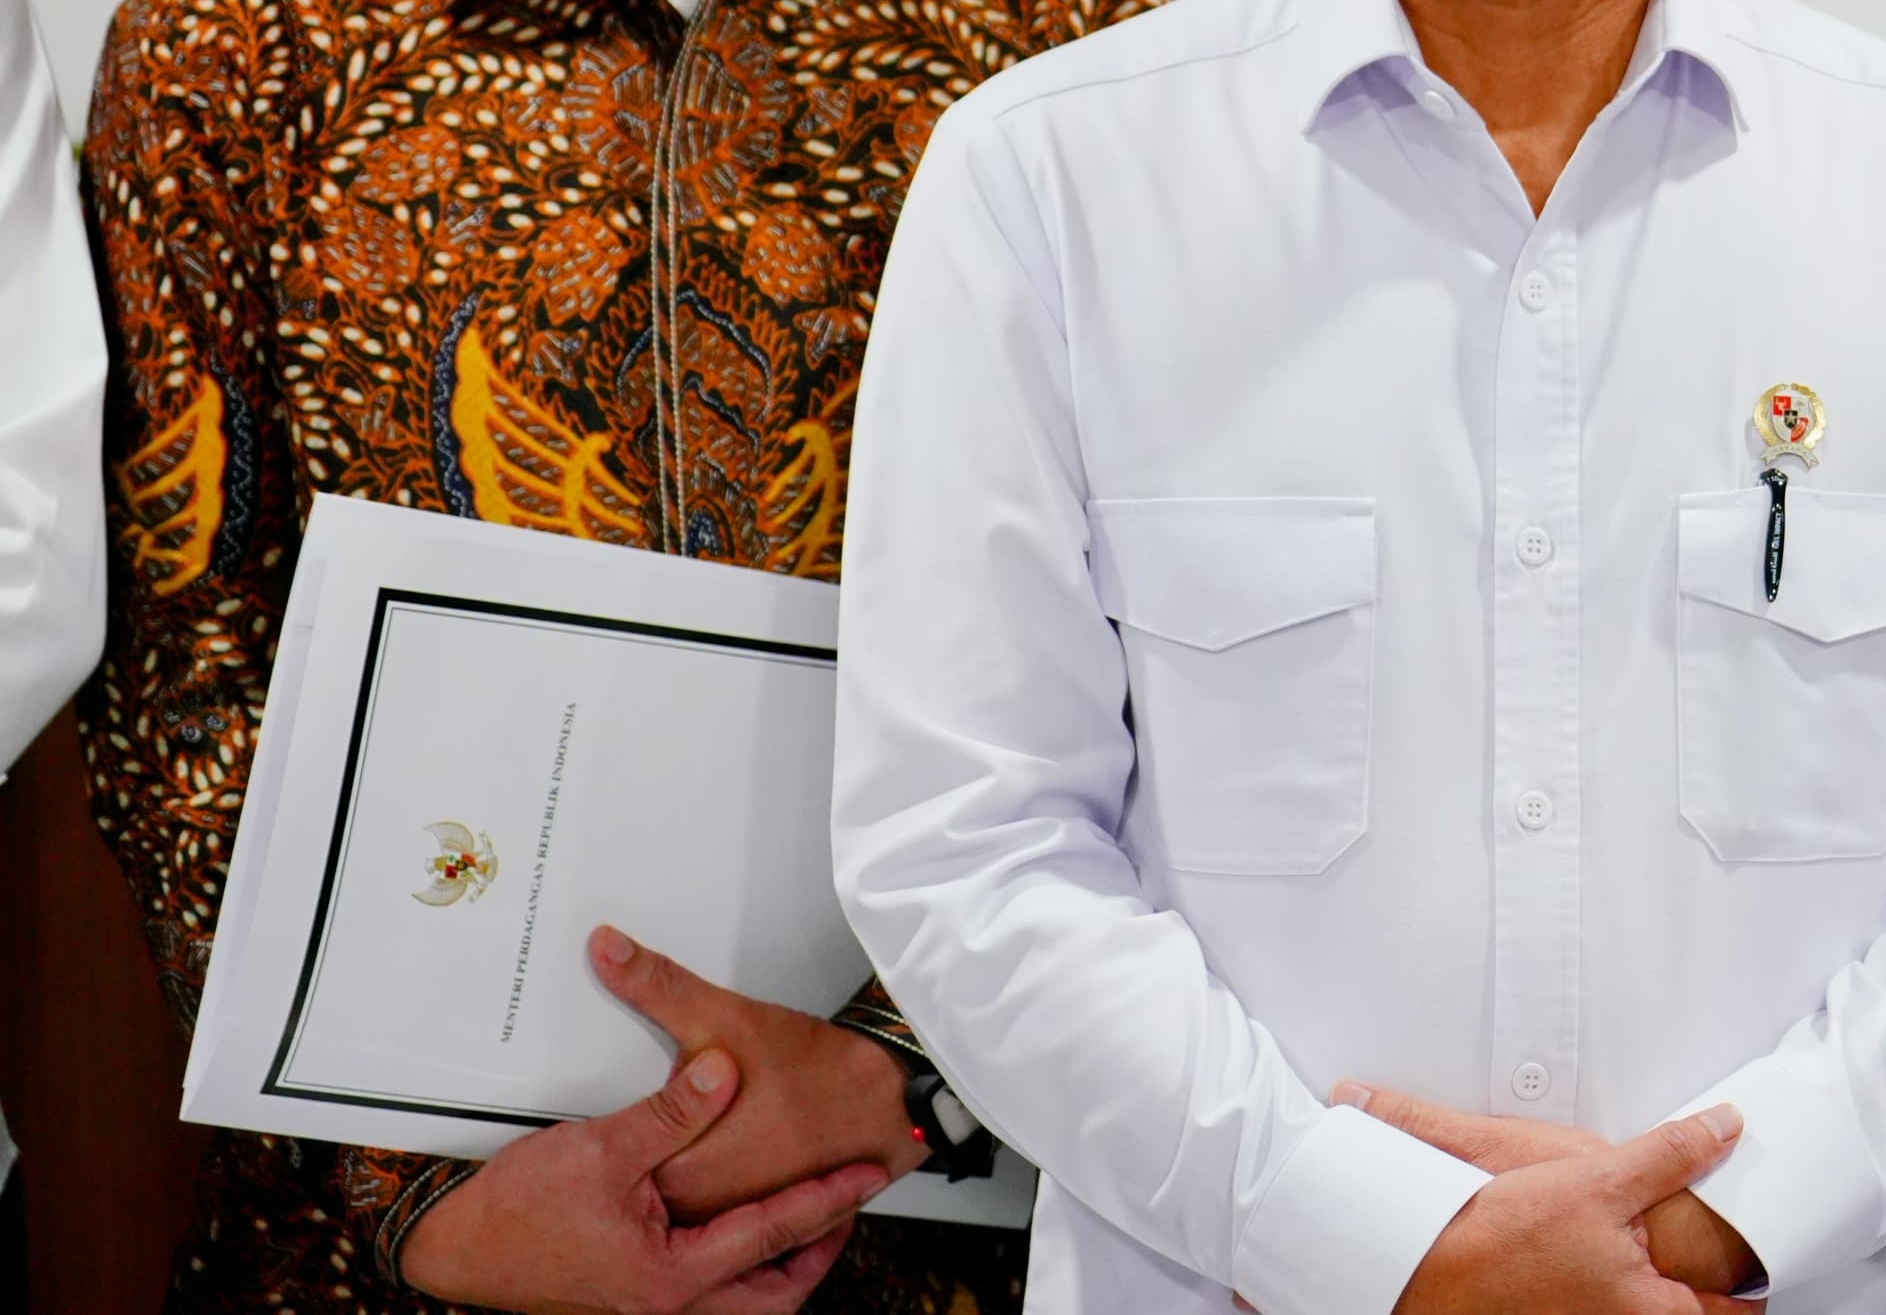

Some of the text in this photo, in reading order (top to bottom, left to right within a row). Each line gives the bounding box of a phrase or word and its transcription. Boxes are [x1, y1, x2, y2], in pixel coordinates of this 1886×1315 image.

[500, 703, 577, 1043] MENTERI PERDAGANGAN REPUBLIK INDONESIA
